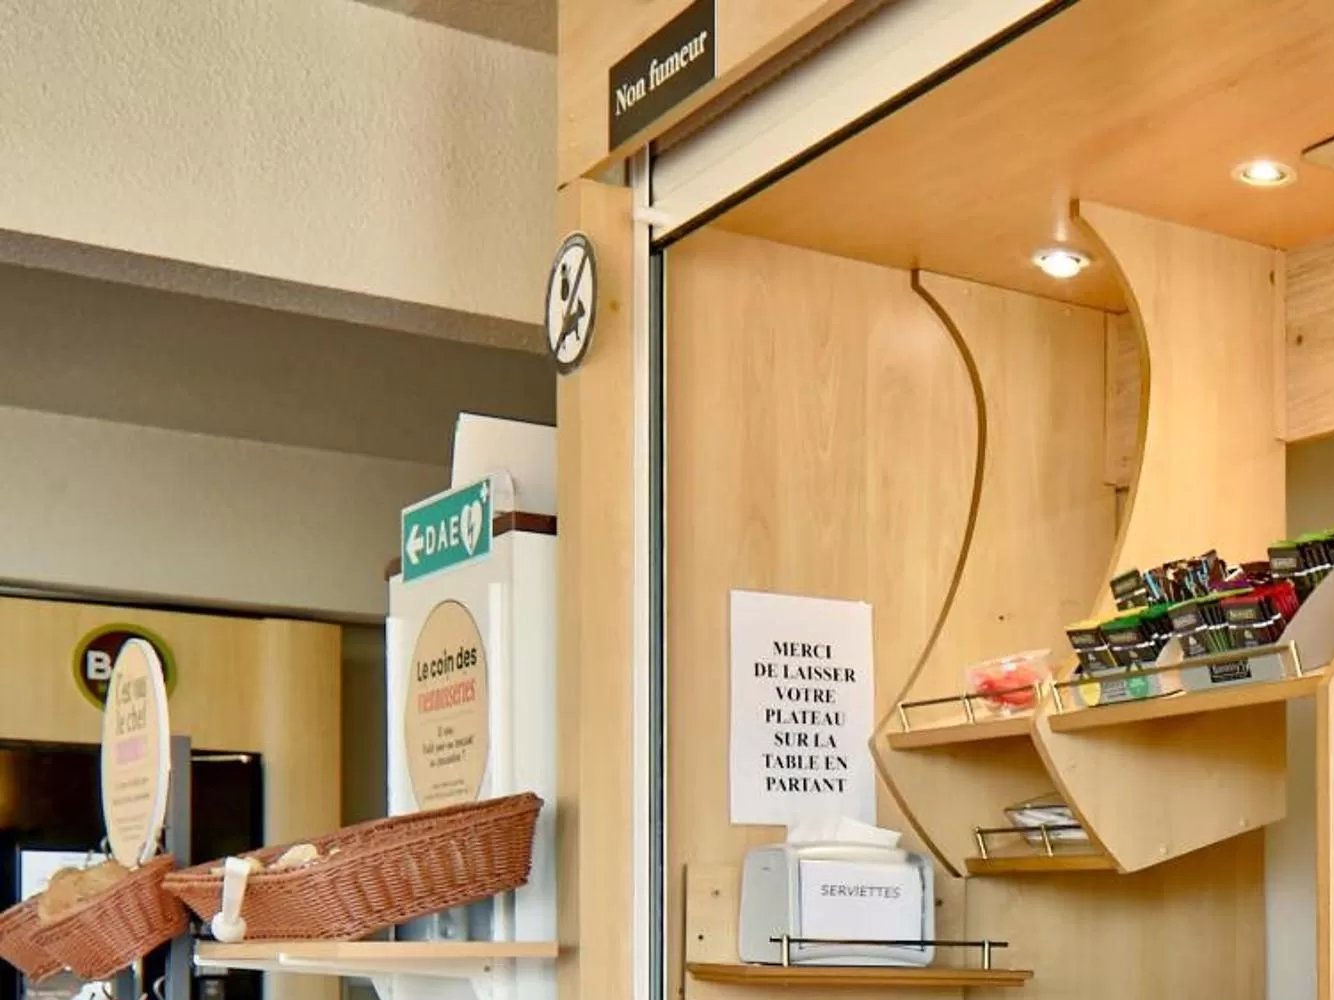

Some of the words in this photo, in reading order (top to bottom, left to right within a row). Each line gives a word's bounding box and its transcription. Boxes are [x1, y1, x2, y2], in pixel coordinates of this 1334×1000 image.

[614, 83, 646, 116] Non
[649, 29, 708, 91] fumeur
[425, 515, 460, 556] DAE
[773, 641, 831, 659] MERCI
[416, 660, 429, 682] Le
[430, 648, 454, 678] coin
[456, 646, 477, 670] des
[754, 661, 778, 678] DE
[783, 663, 856, 682] LAISSER
[775, 686, 837, 704] VOTRE
[765, 708, 845, 726] PLATEAU
[773, 732, 808, 748] SUR
[814, 733, 837, 748] LA
[761, 753, 820, 770] TABLE
[824, 755, 848, 771] EN
[765, 776, 848, 793] PARTANT
[820, 883, 901, 900] SERVIETTES
